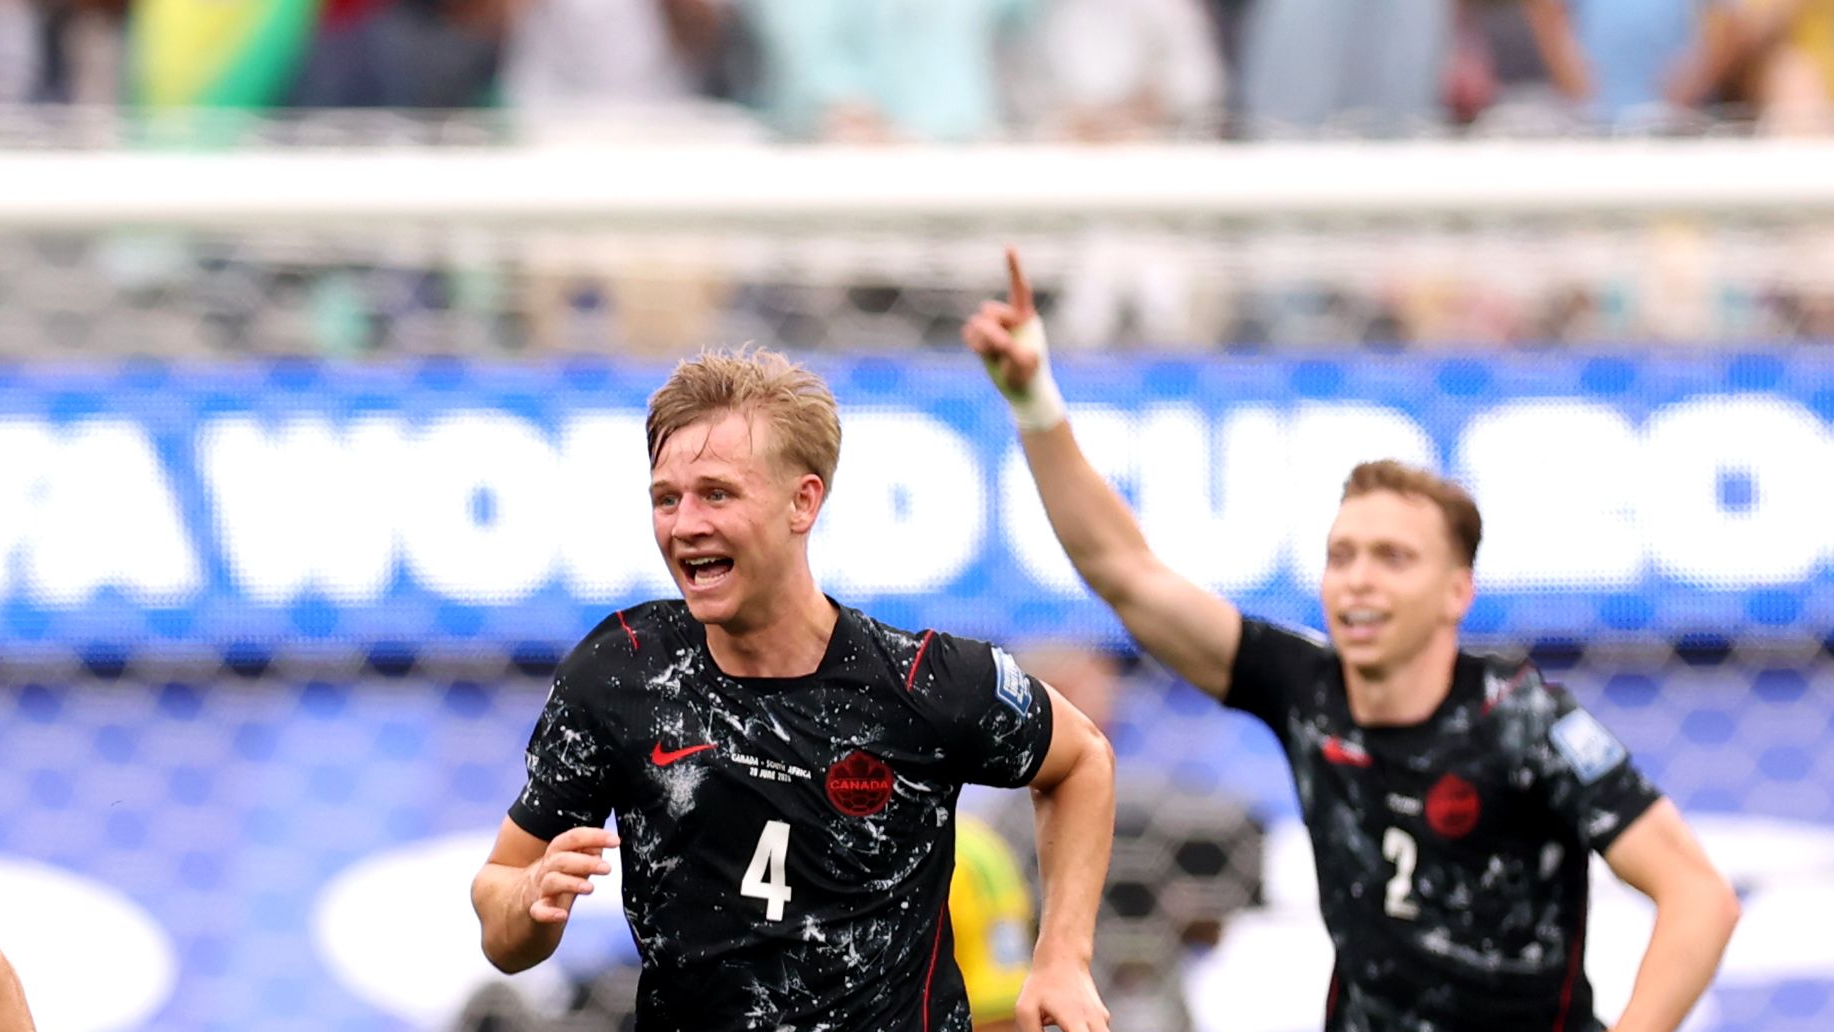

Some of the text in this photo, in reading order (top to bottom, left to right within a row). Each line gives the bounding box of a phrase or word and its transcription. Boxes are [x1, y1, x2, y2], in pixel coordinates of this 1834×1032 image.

[829, 779, 889, 791] CANADA
[740, 820, 792, 921] 4
[1381, 826, 1420, 920] 2
